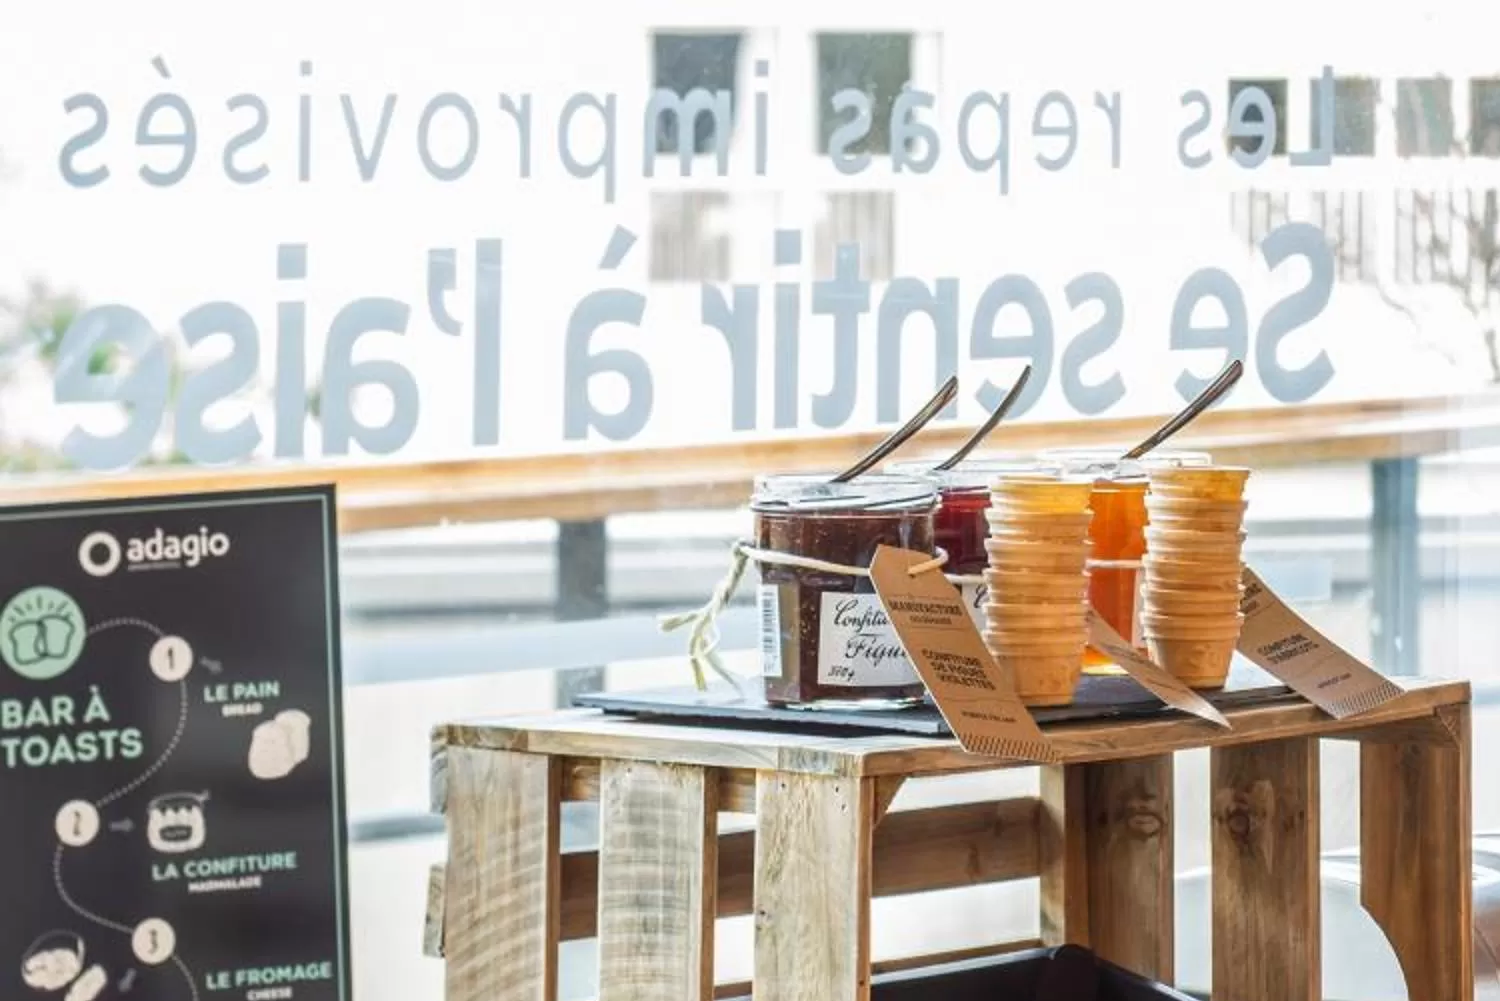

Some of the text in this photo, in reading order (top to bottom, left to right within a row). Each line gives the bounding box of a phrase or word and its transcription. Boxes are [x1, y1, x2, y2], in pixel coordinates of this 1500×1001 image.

[126, 526, 231, 568] adagio
[1, 684, 111, 729] BAR À
[203, 680, 280, 703] LE PAIN
[0, 727, 144, 768] TOASTS
[151, 851, 298, 881] LA CONFITURE
[205, 961, 333, 991] LE FROMAGE
